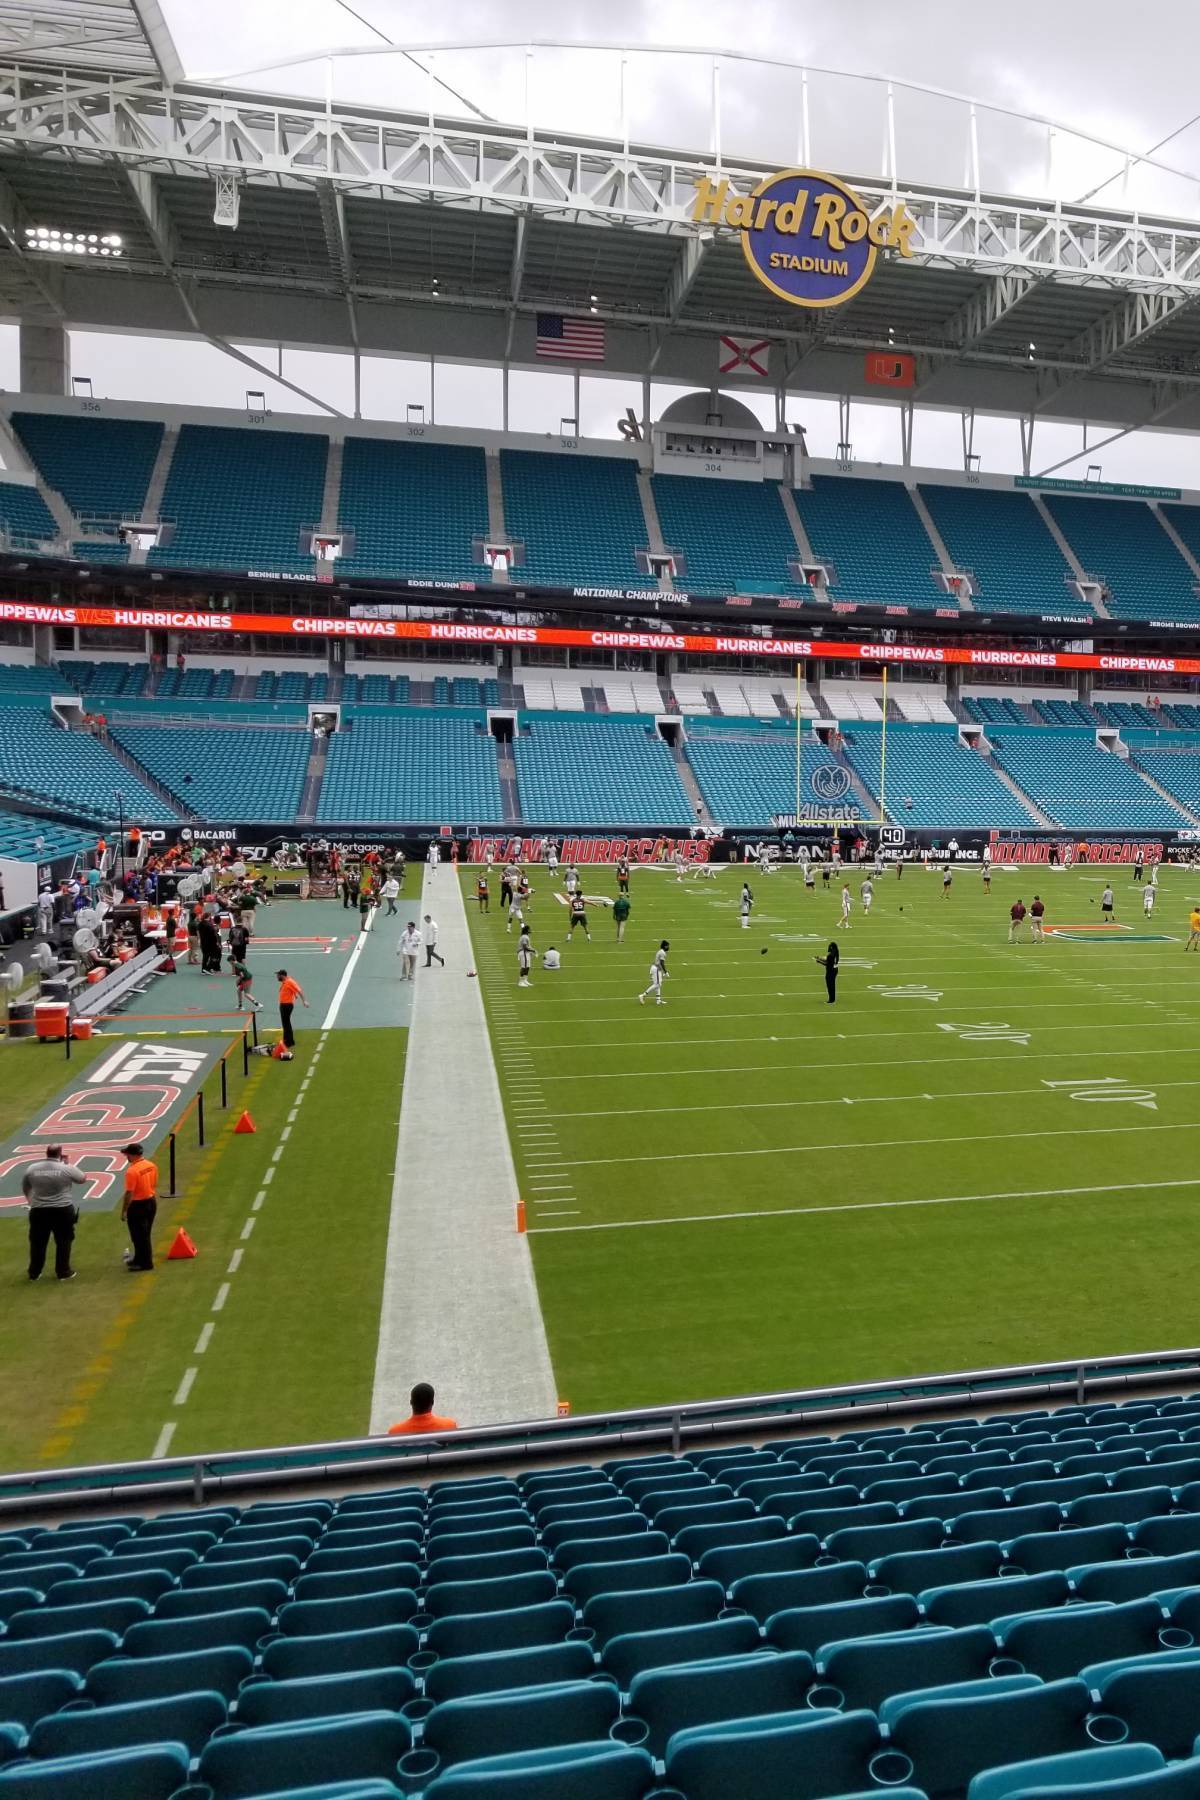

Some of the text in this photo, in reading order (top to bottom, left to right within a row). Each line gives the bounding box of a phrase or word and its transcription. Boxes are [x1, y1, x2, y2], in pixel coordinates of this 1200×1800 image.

[691, 177, 916, 258] Hard Rock
[769, 251, 850, 276] STADIUM
[407, 427, 425, 437] 302
[560, 440, 578, 449] 303
[704, 463, 722, 472] 304
[282, 573, 316, 581] BLADES
[435, 581, 459, 589] DUNN
[574, 588, 688, 603] NATIONAL CHAMPIONS
[0, 604, 76, 622] IPPEWAS
[115, 611, 232, 628] HURRICANES
[292, 619, 396, 635] CHIPPEWAS
[431, 625, 537, 641] HURRICANES
[591, 632, 685, 648] CHIPPEWAS
[716, 638, 811, 654] HURRICANES
[860, 645, 944, 660] CHIPPEWAS
[972, 651, 1056, 665] HURRICANES
[1100, 656, 1175, 671] CHIPPEWAS
[800, 802, 860, 820] Allstate
[193, 829, 237, 840] BACARDÍ
[883, 830, 901, 842] 40
[333, 842, 385, 854] Mortgage
[573, 901, 583, 909] 95
[936, 1021, 1032, 1040] 20
[1040, 1077, 1158, 1103] 10
